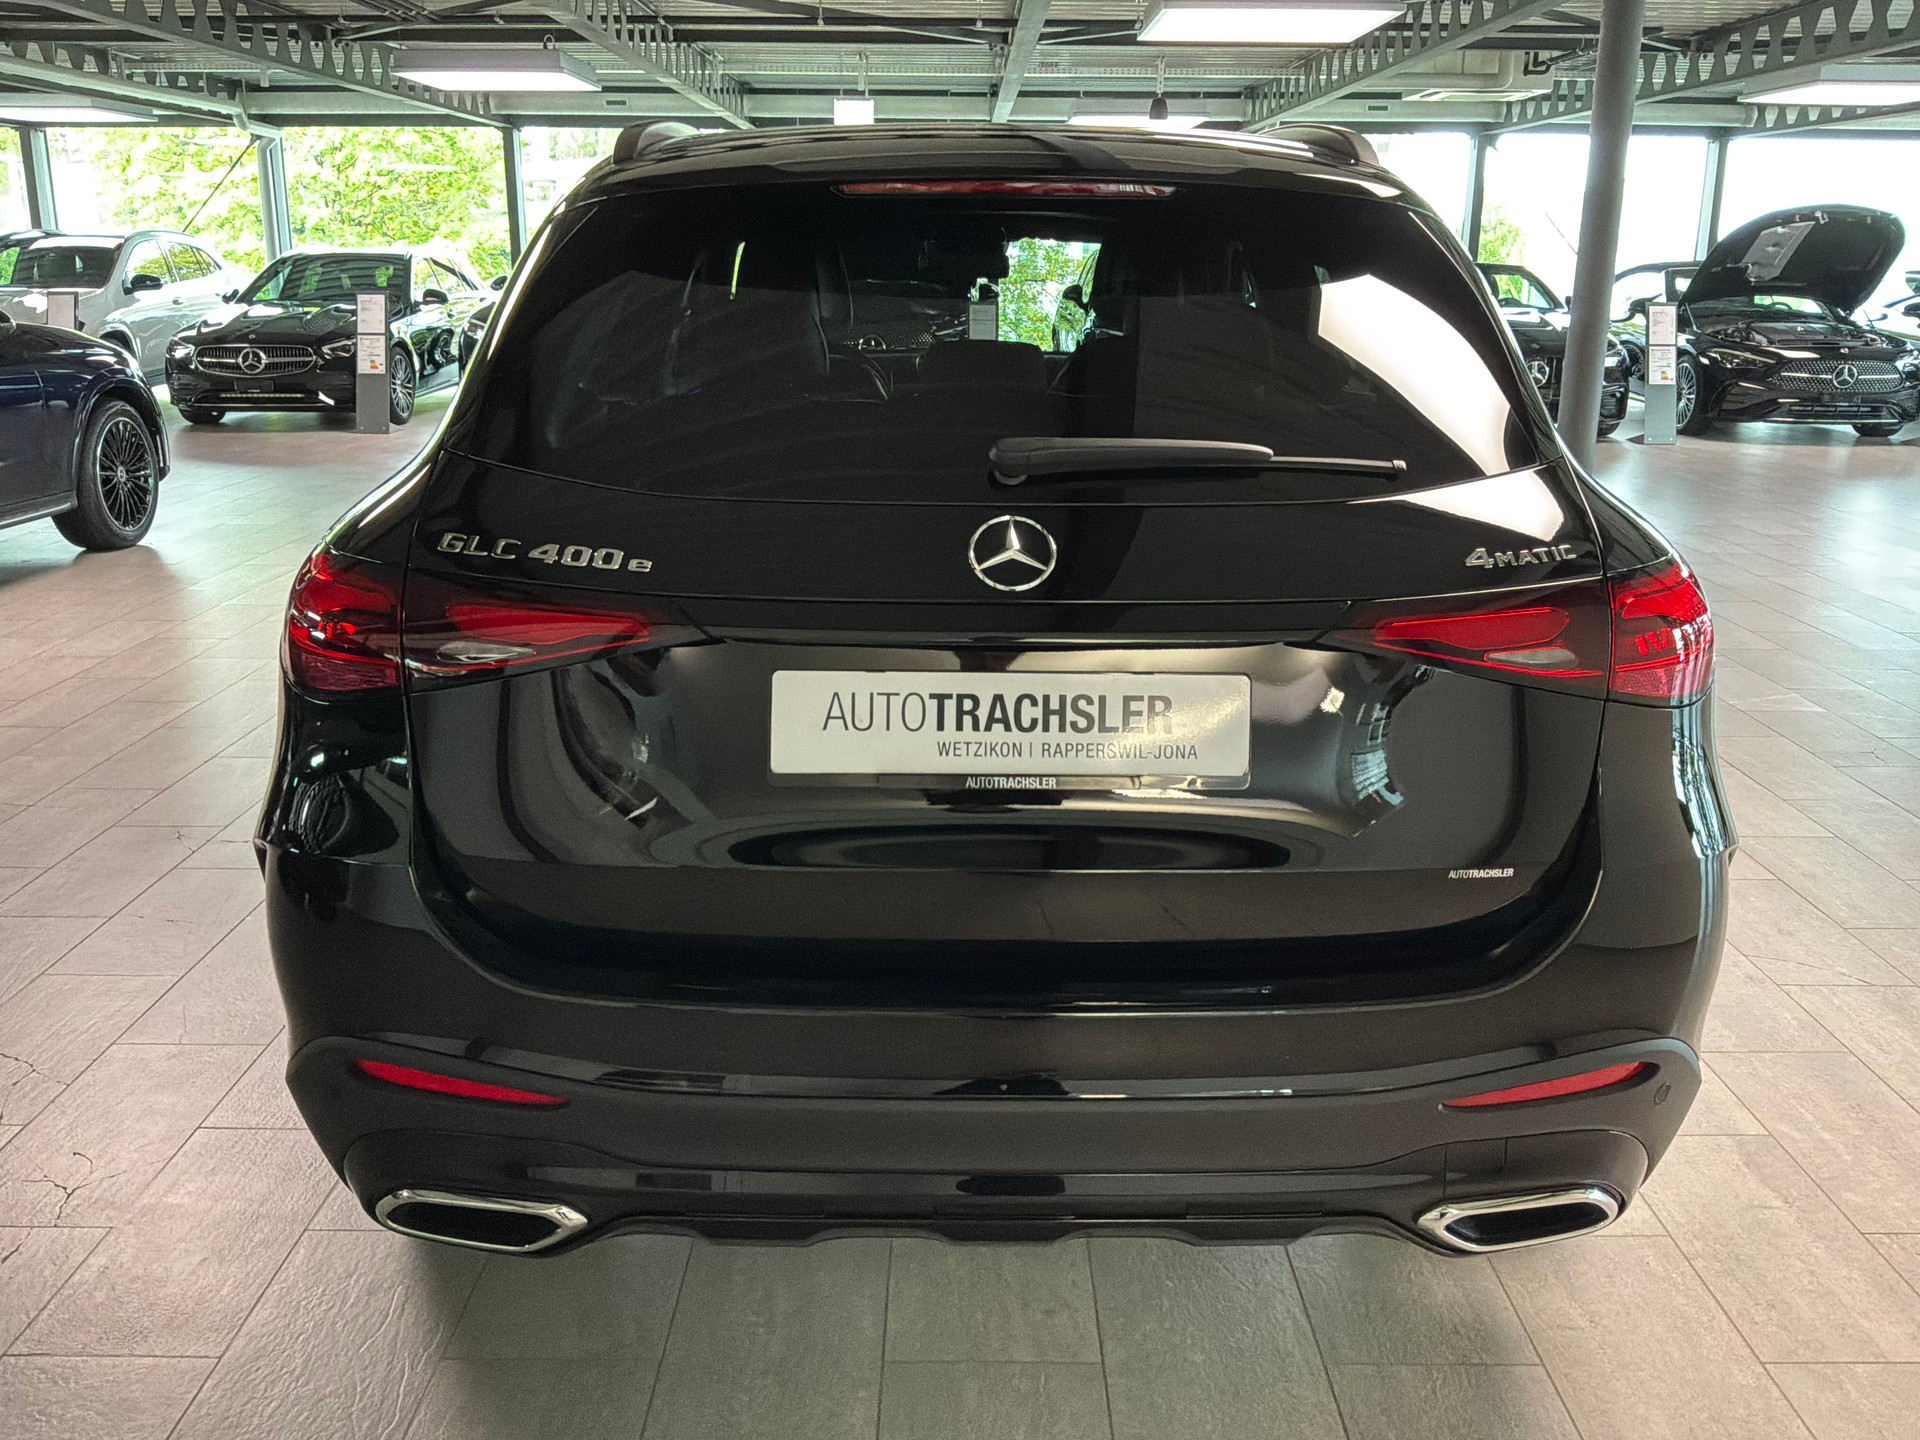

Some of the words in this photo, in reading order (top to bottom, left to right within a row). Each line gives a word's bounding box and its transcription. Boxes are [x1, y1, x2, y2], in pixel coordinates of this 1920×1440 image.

[437, 532, 522, 560] GLC
[1464, 544, 1578, 569] 4MATIC
[822, 691, 1173, 735] AUTOTRACHSLER
[937, 741, 1022, 758] WETZIKON
[1041, 742, 1198, 760] RAPPERSWIL-JONA
[965, 776, 1057, 789] AUTOTRACHSLER
[1448, 868, 1514, 879] AUTOTRACHSLER
